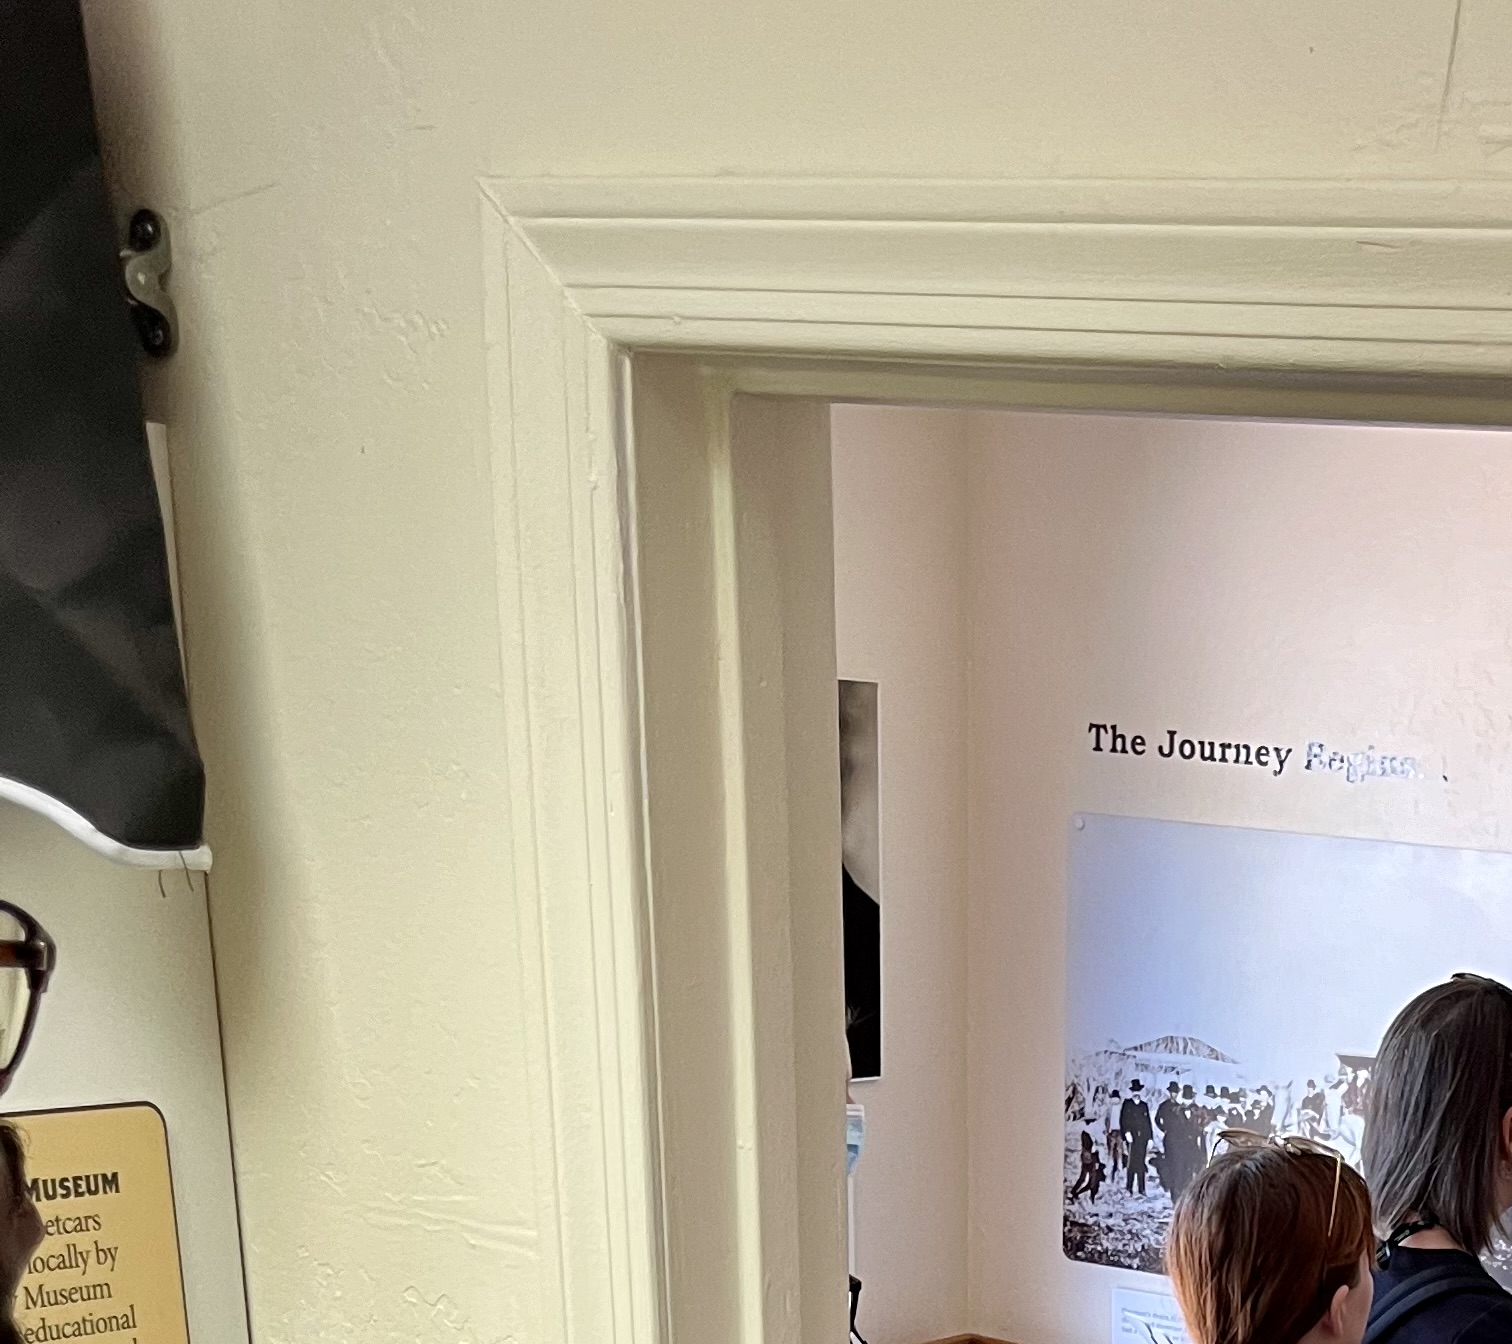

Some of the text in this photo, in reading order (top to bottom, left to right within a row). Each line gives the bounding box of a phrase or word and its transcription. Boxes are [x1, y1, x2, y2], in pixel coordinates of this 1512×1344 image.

[1088, 722, 1146, 756] The
[1158, 729, 1293, 777] Journey
[25, 1172, 120, 1202] MUSEUM
[94, 1240, 118, 1272] by
[23, 1282, 112, 1310] Museum
[24, 1304, 137, 1344] educational
